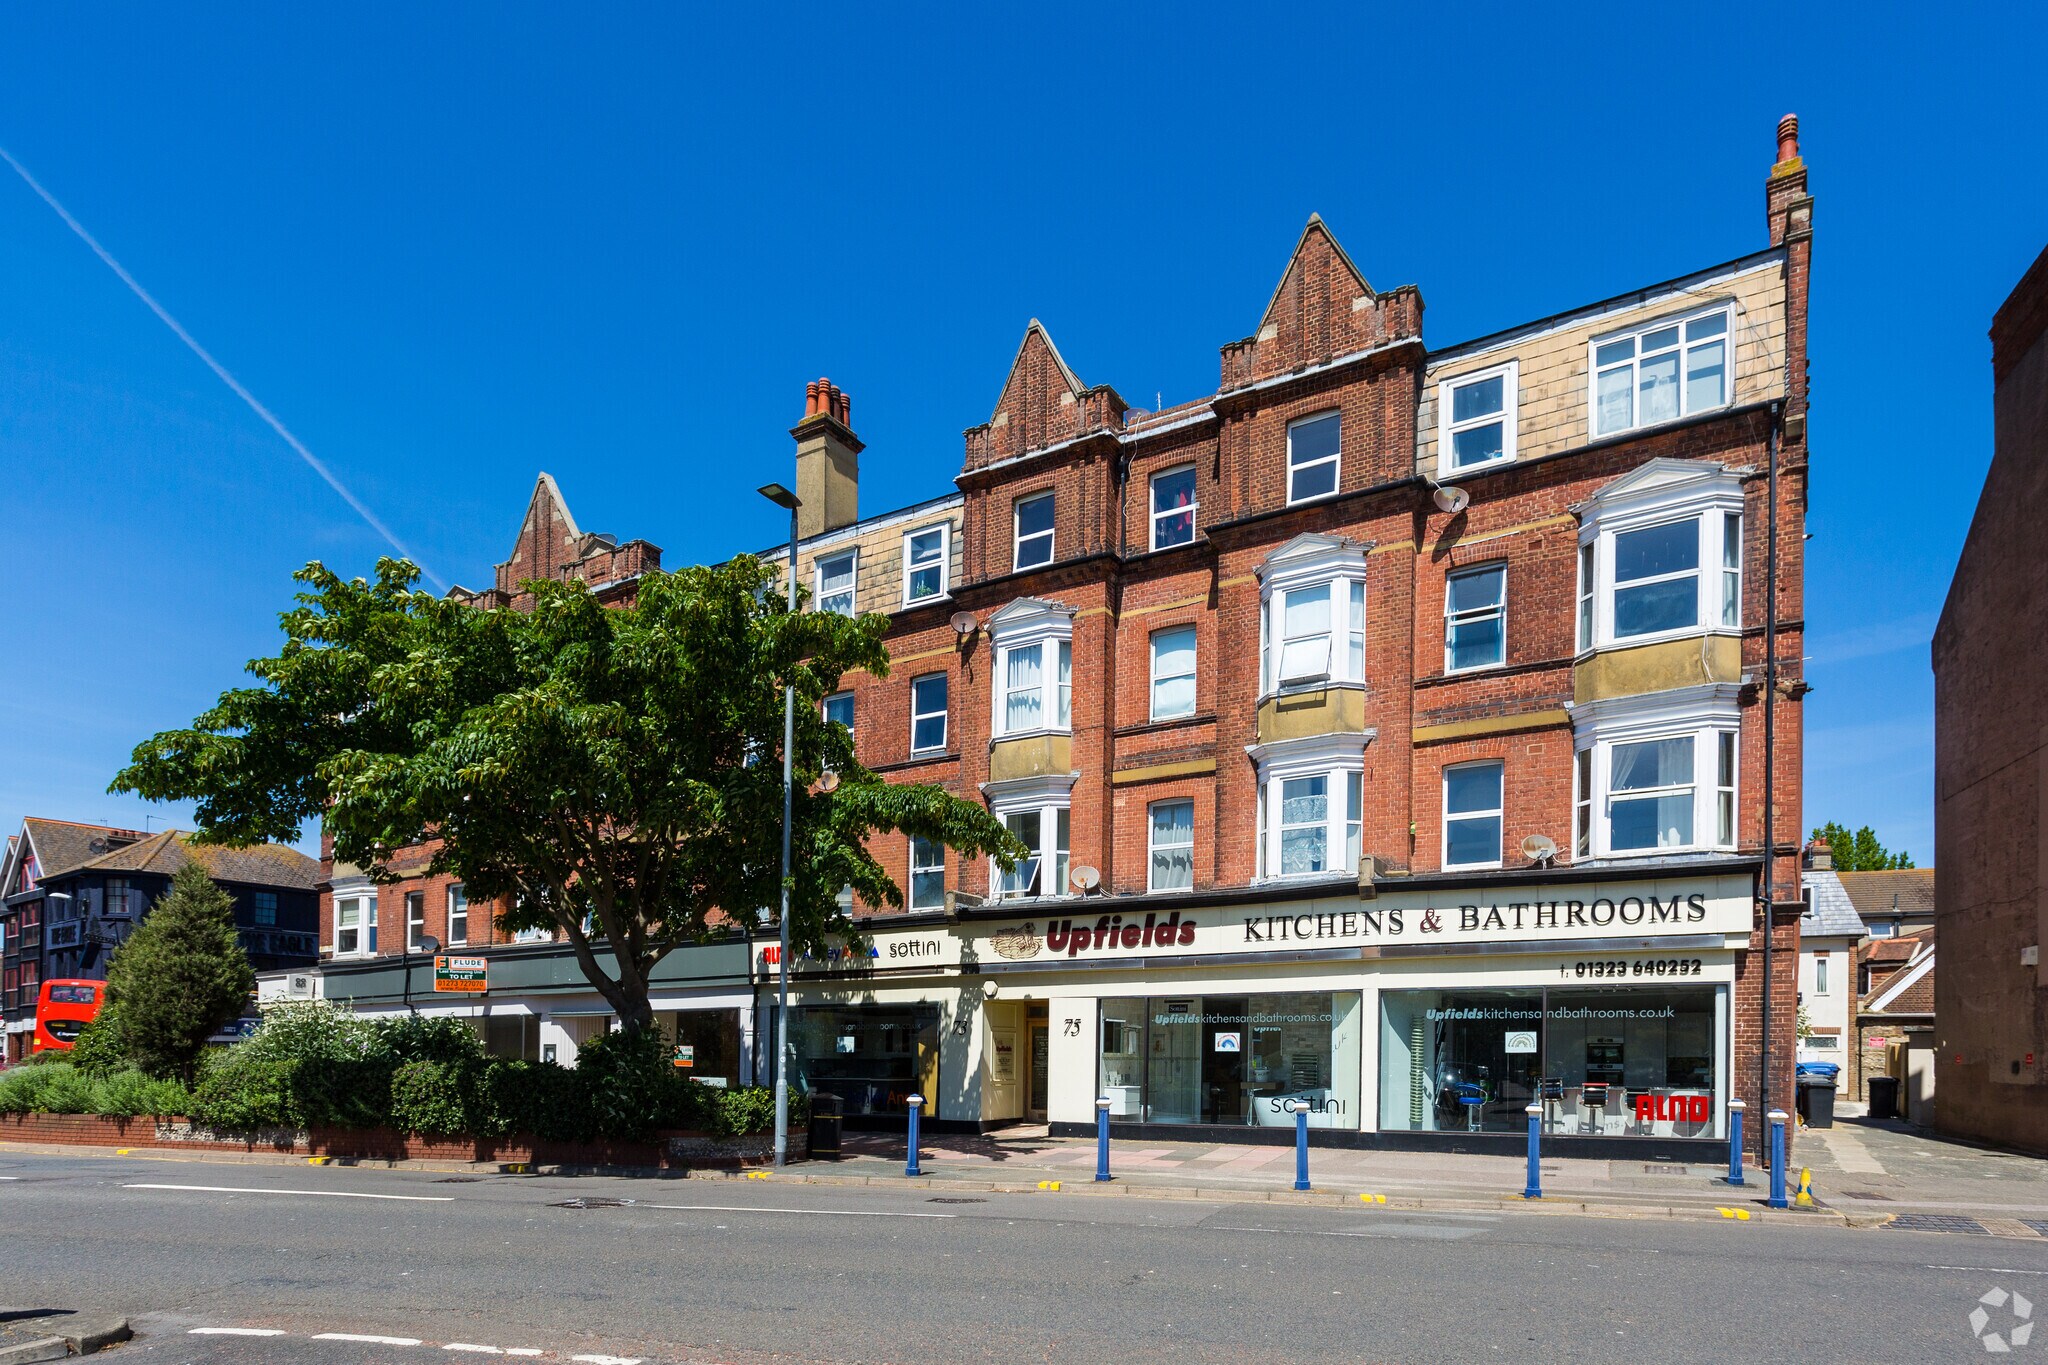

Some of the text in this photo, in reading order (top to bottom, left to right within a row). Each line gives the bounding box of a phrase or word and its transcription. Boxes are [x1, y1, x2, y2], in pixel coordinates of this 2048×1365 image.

[1047, 894, 1706, 957] Upfields KITCHENS & BATHROOMS
[802, 946, 841, 962] Aey
[889, 940, 941, 958] sottini
[1575, 962, 1627, 978] 01323
[1632, 959, 1702, 977] 640252
[953, 1020, 968, 1036] 73
[1063, 1018, 1082, 1037] 75
[1270, 1096, 1346, 1114] sotini
[1636, 1095, 1709, 1122] ALNO
